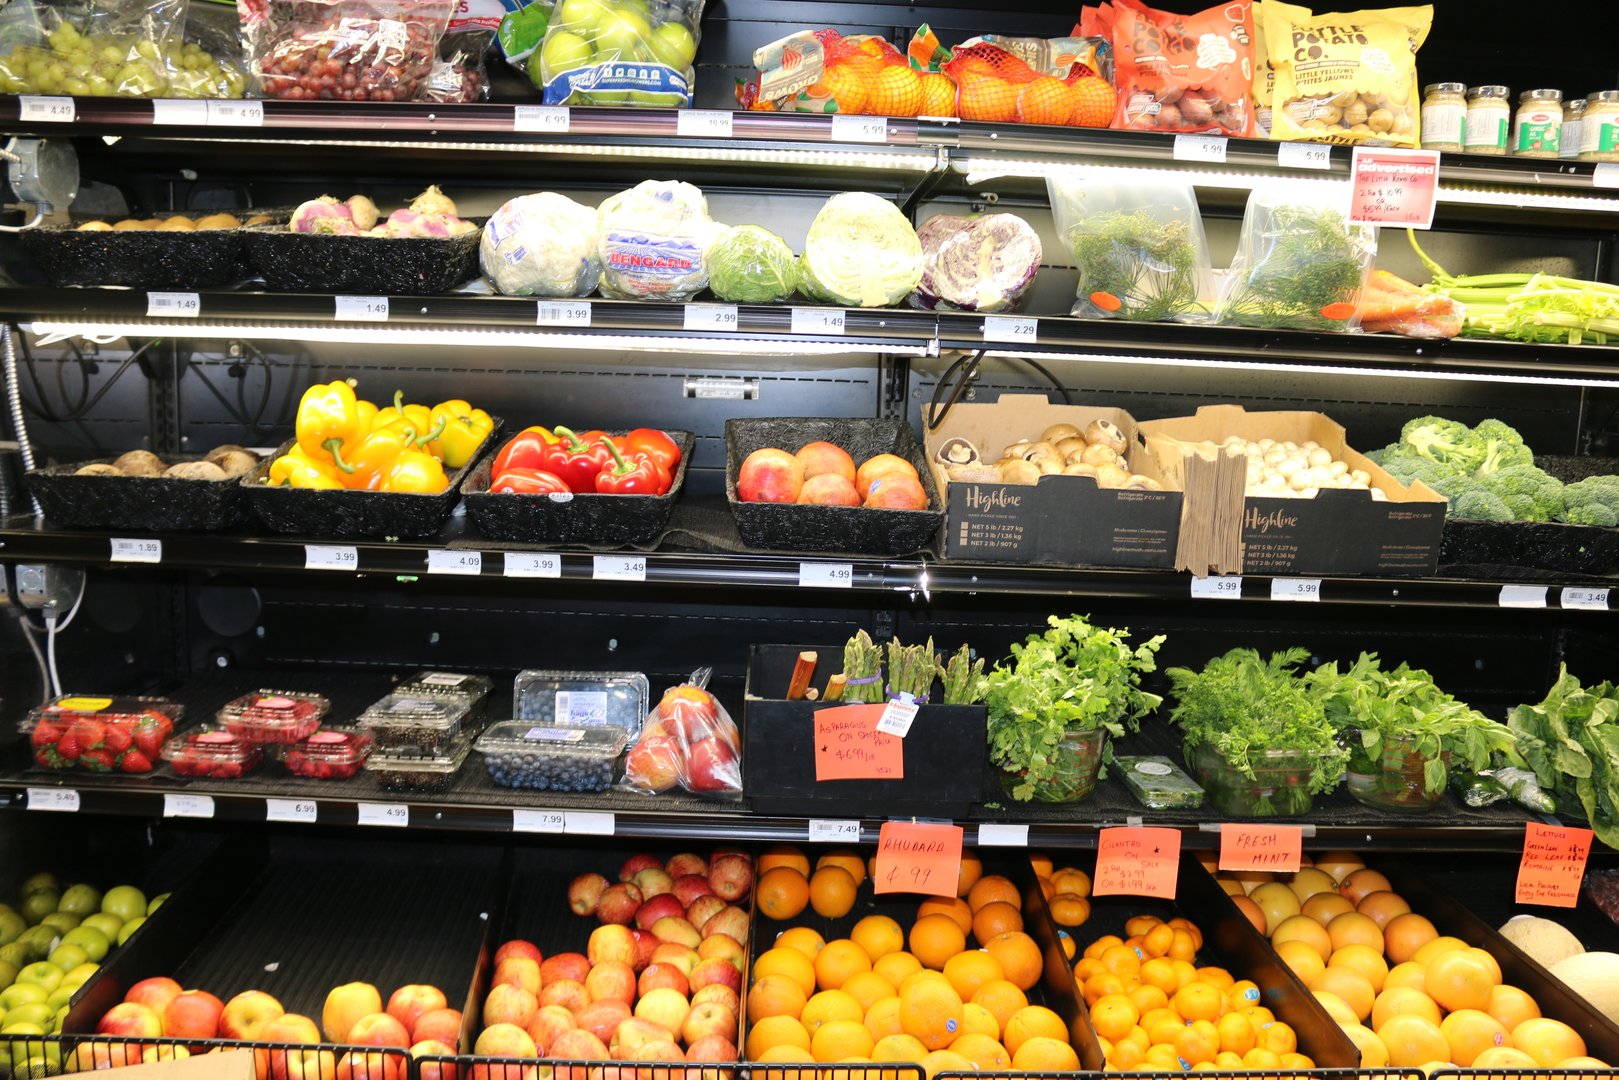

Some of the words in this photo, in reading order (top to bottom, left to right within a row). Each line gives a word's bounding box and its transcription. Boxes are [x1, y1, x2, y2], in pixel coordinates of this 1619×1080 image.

[1296, 71, 1318, 80] LITTLE
[51, 106, 71, 115] 4.49
[240, 108, 260, 118] 4.99
[863, 126, 884, 134] 5.99
[1203, 144, 1222, 154] 5.99
[1306, 152, 1326, 160] 5.99
[1358, 163, 1434, 174] advertised
[610, 253, 692, 269] BENGARD
[177, 300, 196, 308] 1.49
[367, 304, 386, 312] 1.49
[566, 310, 587, 318] 3.99
[716, 314, 736, 322] 2.99
[824, 318, 843, 326] 1.49
[1014, 326, 1034, 334] 2.29
[967, 485, 1021, 513] Highline
[1245, 507, 1298, 534] Highline
[139, 544, 157, 552] 1.89
[460, 557, 480, 565] 4.09
[534, 560, 553, 568] 3.99
[624, 563, 644, 571] 3.49
[830, 570, 850, 578] 4.99
[1218, 582, 1236, 590] 5.99
[1298, 584, 1316, 592] 5.99
[1588, 594, 1606, 602] 3.49
[820, 721, 866, 734] ASPARAGUS
[838, 732, 852, 742] ON
[56, 792, 74, 800] 5.49
[296, 804, 314, 812] 6.99
[838, 825, 857, 833] 7.49
[1536, 828, 1566, 838] LETTUCE
[884, 838, 944, 852] RHUBARB
[1102, 840, 1141, 850] CILANTRO
[1236, 833, 1276, 849] FRESH
[1125, 851, 1138, 860] ON
[1252, 852, 1290, 864] MINT
[1141, 860, 1158, 868] SALE
[1103, 866, 1110, 874] 2
